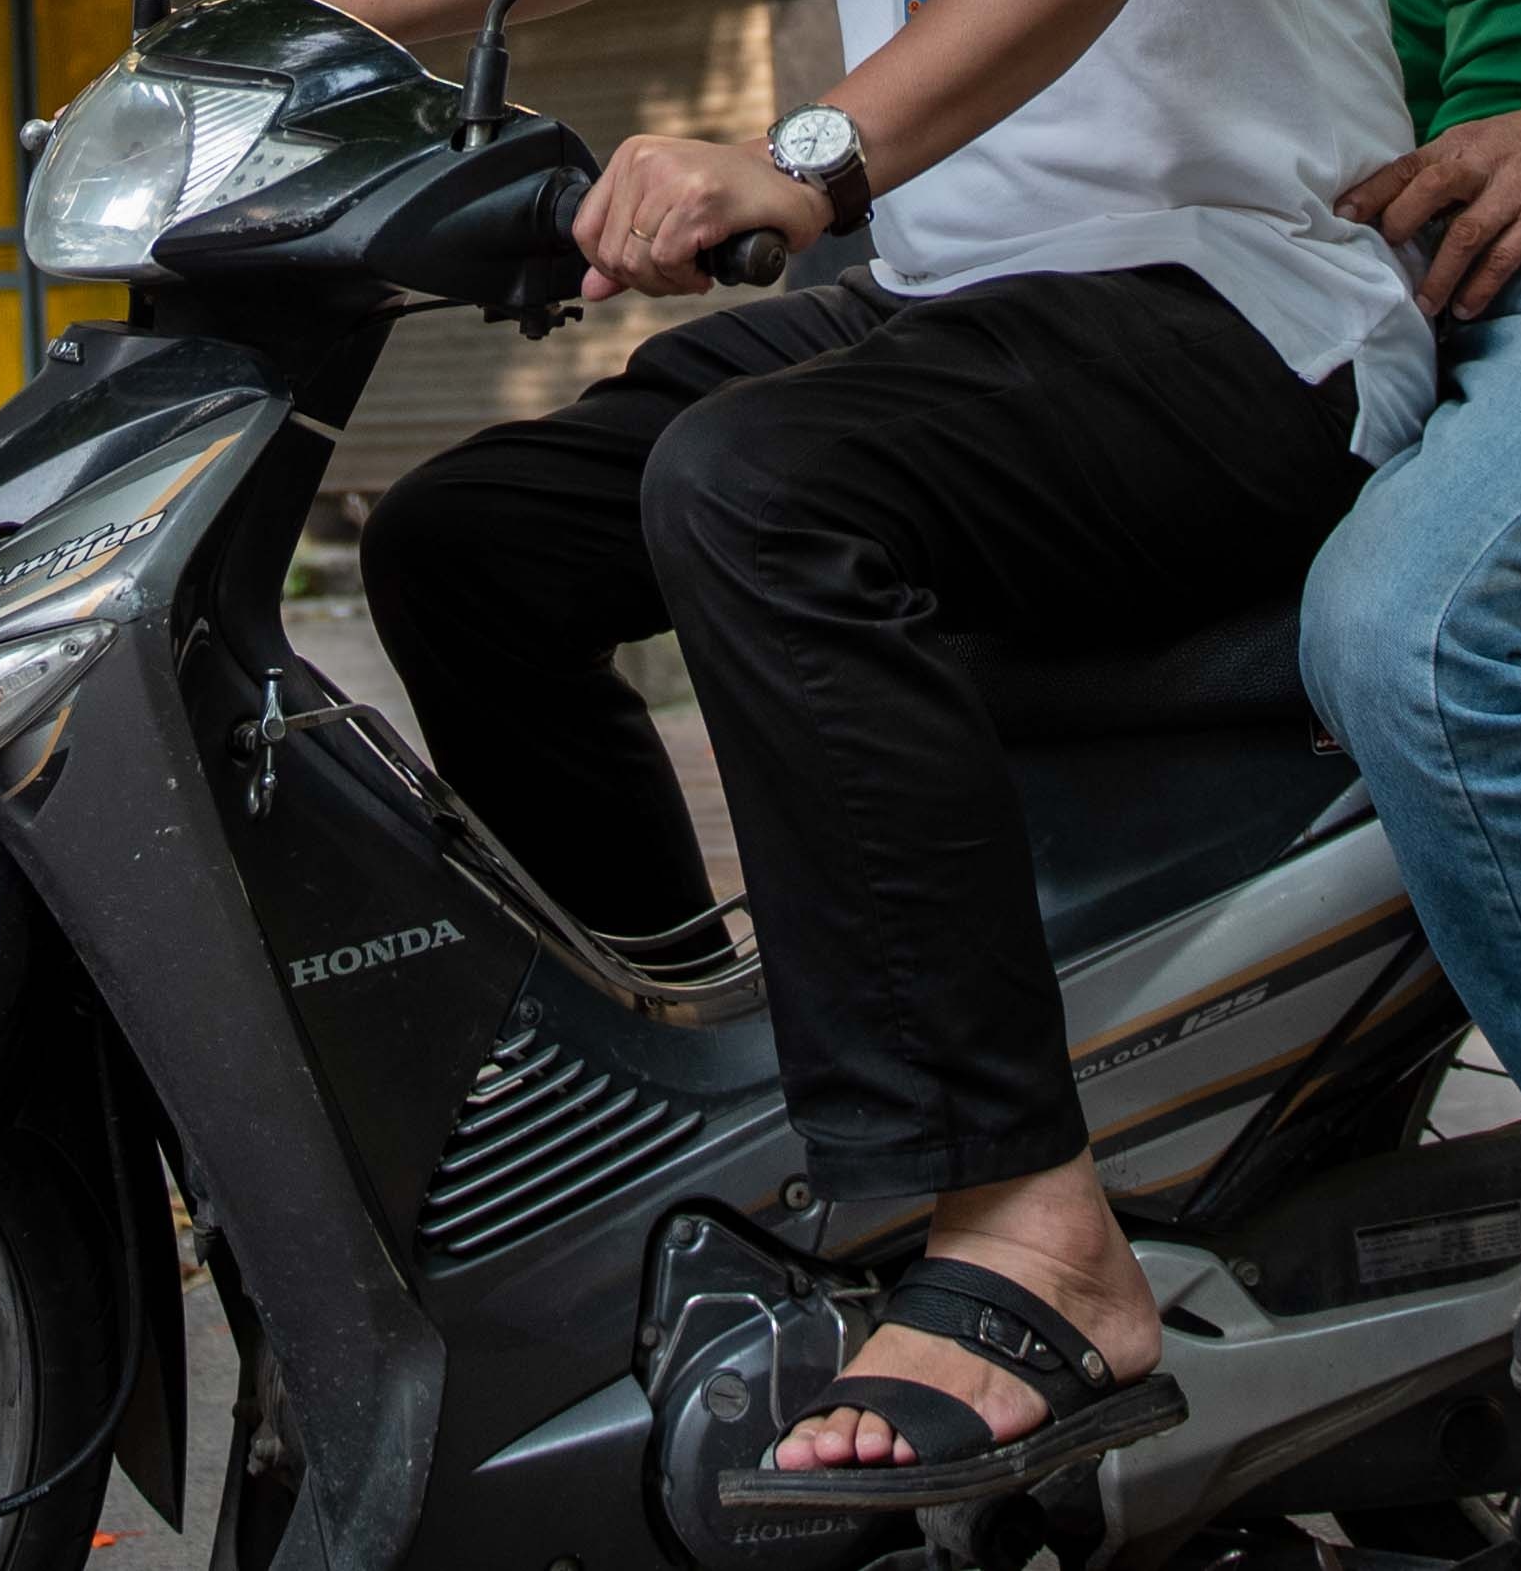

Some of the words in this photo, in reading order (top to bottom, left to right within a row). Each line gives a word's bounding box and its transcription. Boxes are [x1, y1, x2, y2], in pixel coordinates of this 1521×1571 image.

[47, 510, 168, 580] neo
[289, 919, 465, 987] HONDA
[1072, 1033, 1168, 1080] OLOGY
[1179, 982, 1270, 1038] 125
[734, 1516, 858, 1543] HONDA
